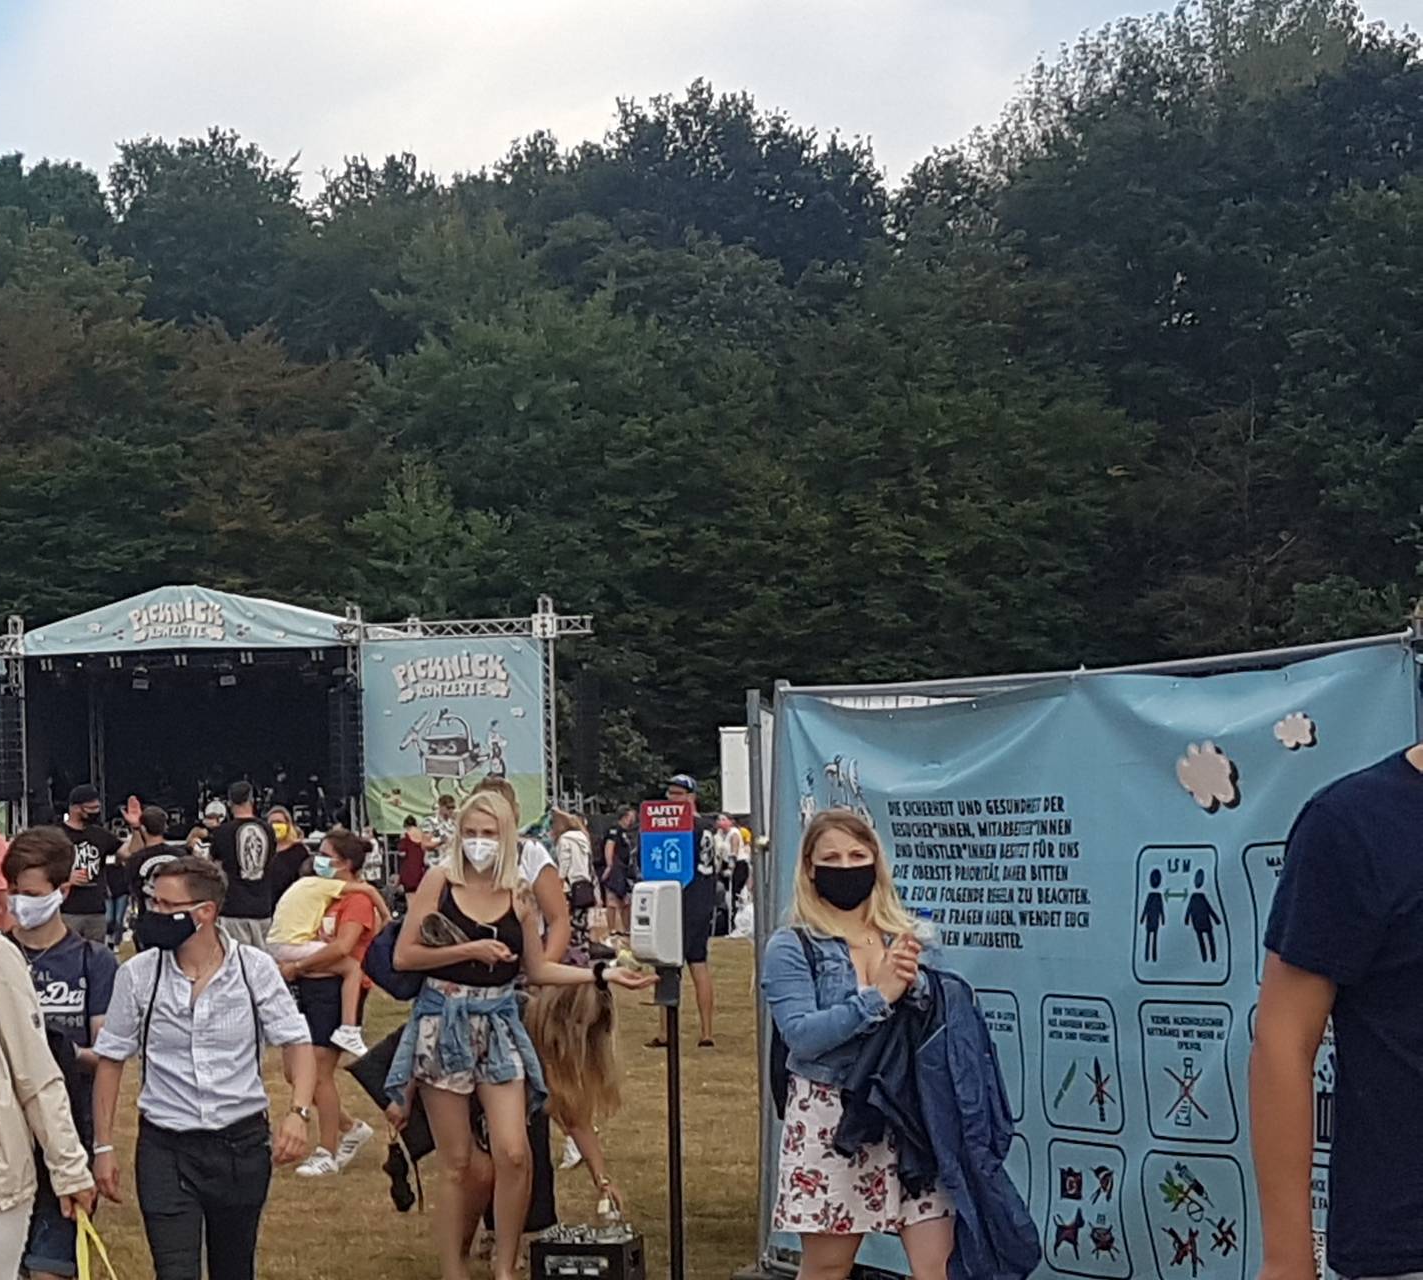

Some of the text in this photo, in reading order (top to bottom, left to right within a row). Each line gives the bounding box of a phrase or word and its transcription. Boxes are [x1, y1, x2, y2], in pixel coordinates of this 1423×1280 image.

[646, 804, 685, 816] SAFETY
[958, 800, 982, 816] UND
[1043, 796, 1065, 813] DER
[651, 816, 681, 828] FIRST
[1033, 839, 1055, 858] FÜR
[1059, 841, 1079, 858] UNS
[1030, 864, 1069, 881] BITTEN
[1018, 887, 1033, 904] ZU
[1018, 910, 1061, 927] WENDET
